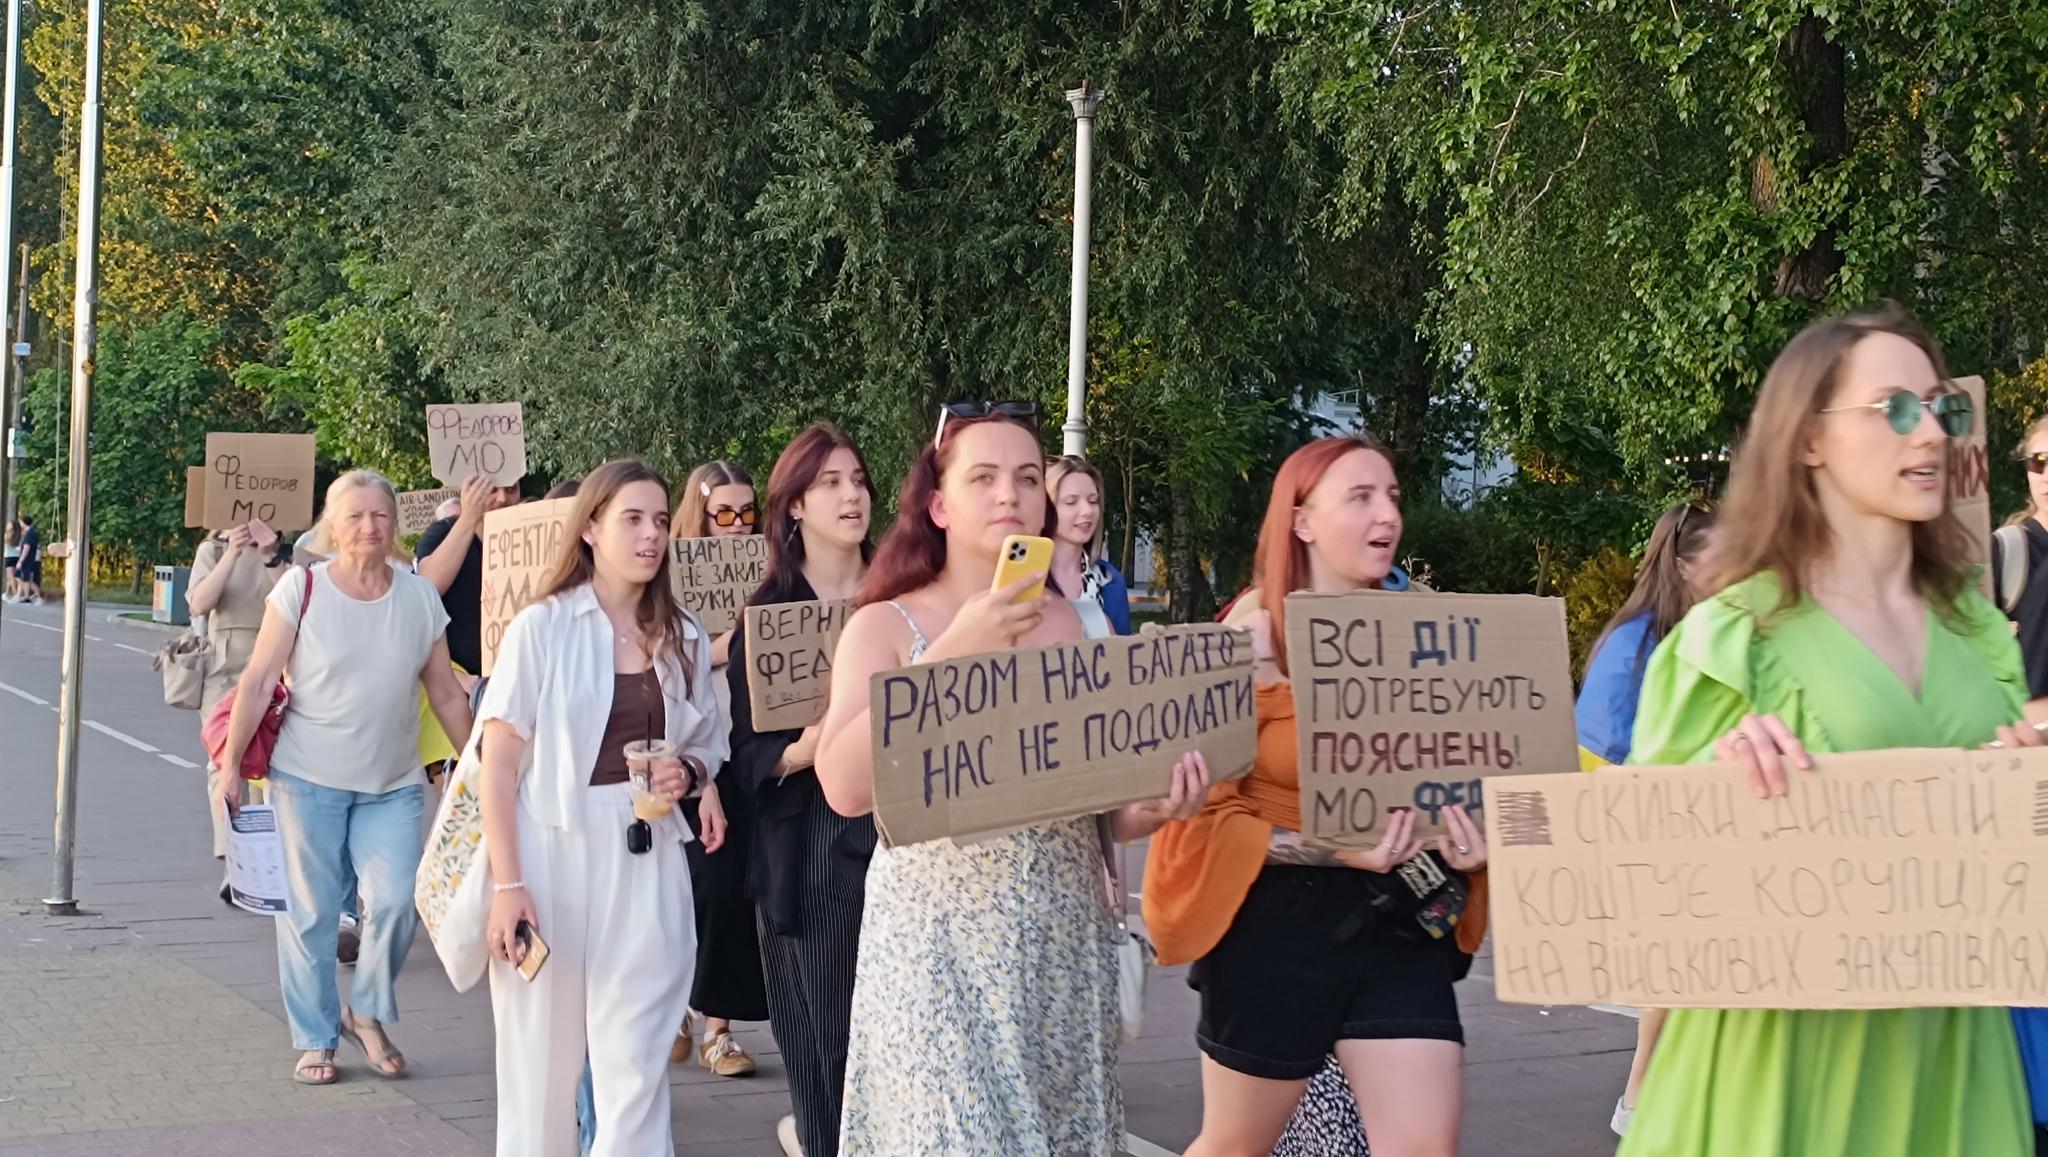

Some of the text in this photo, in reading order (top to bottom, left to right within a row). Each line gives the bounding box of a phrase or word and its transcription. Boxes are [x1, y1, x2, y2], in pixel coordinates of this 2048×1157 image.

[428, 408, 521, 439] ФЕДОРОВ
[449, 441, 505, 475] МО
[231, 499, 276, 522] МО
[675, 539, 722, 564] НАМ
[681, 565, 703, 587] НЕ
[683, 589, 735, 611] РУКИ
[1309, 618, 1384, 668] ВСІ
[883, 631, 1236, 747] РАЗОМ НАС БАГАТО
[1311, 675, 1546, 723] ПОТРЕБУЮТЬ
[923, 675, 1254, 808] НАС НЕ ПОДОЛАТИ
[1312, 731, 1521, 776] ПОЯСНЕНЬ!
[1313, 787, 1377, 833] МО
[1573, 773, 1741, 845] СКІЛЬКИ
[1512, 861, 1719, 927] КОШТУЄ
[1752, 851, 2031, 922] КОРУПЦІЯ
[1504, 939, 1570, 998] НА
[1586, 930, 1804, 999] ВІЙСЬКОВИХ
